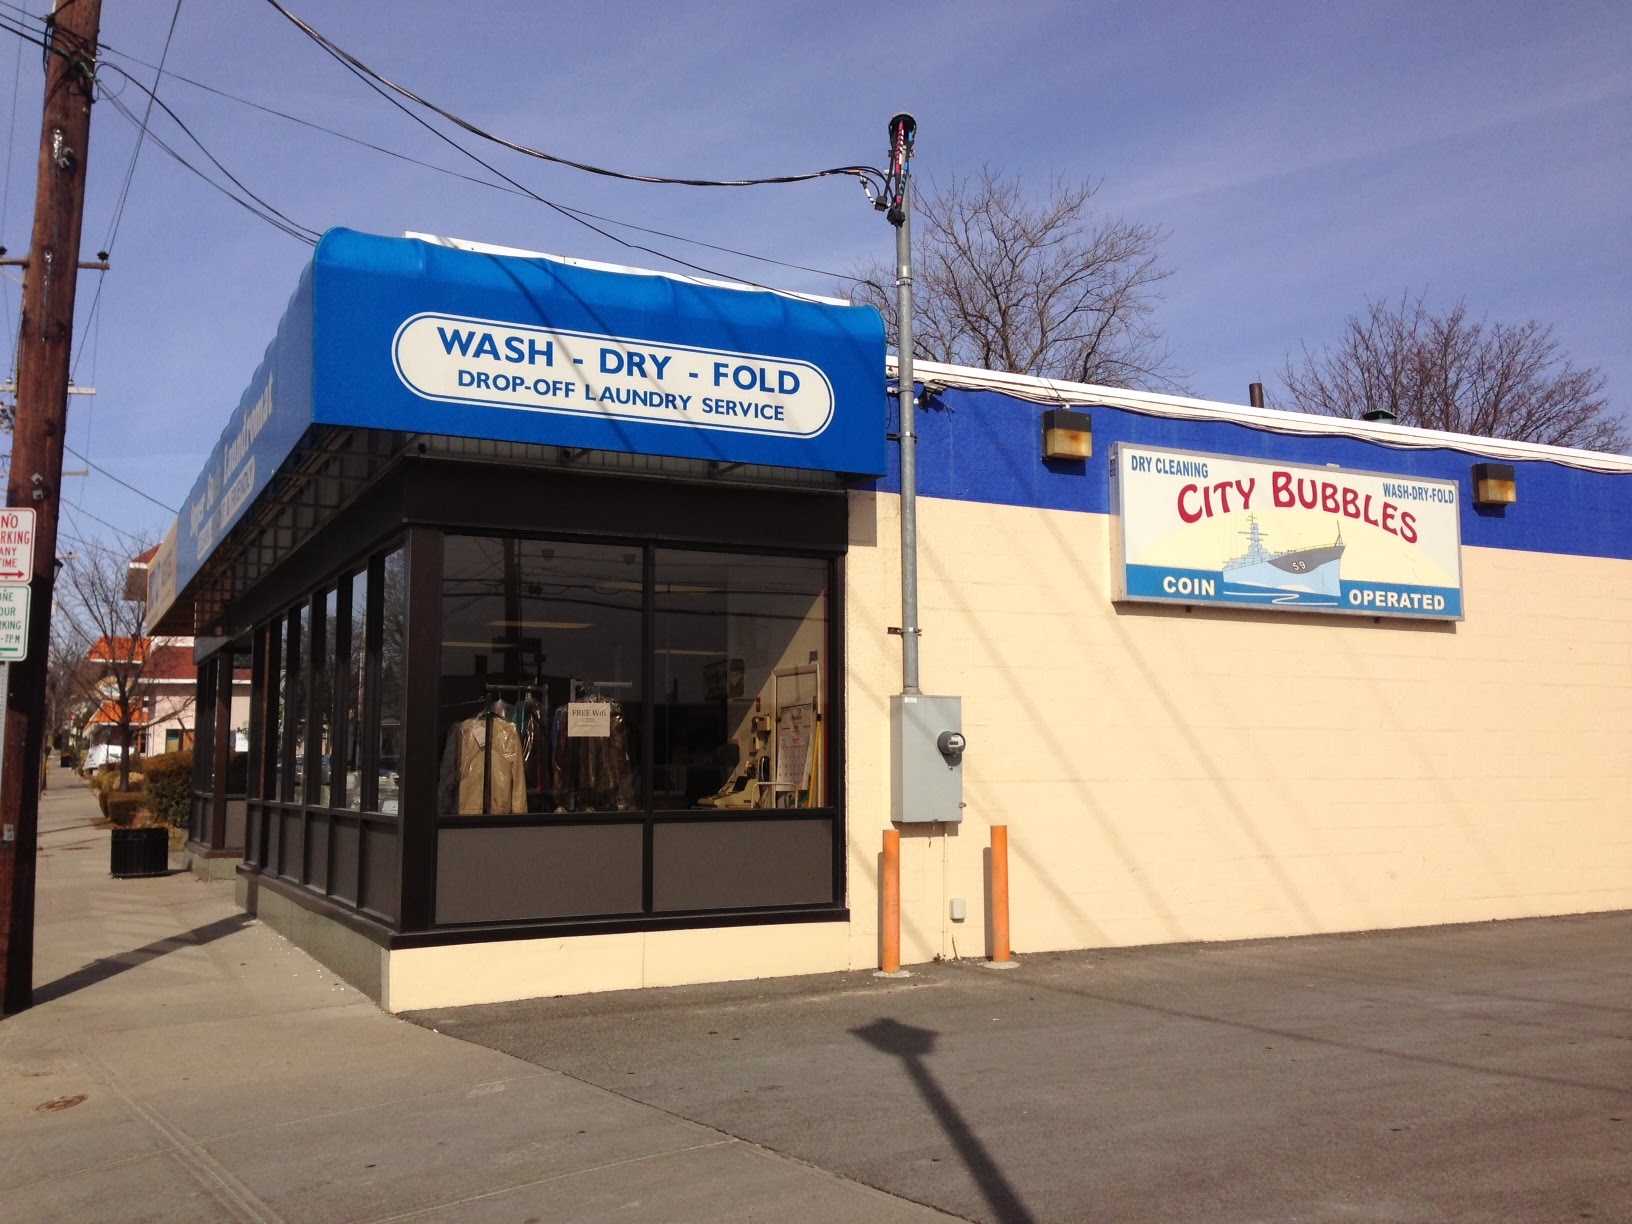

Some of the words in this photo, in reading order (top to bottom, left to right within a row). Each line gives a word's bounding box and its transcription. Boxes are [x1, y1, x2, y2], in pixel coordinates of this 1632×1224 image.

[437, 327, 554, 367] WASH
[600, 348, 672, 380] DRY
[713, 362, 800, 394] FOLD
[457, 370, 576, 398] DROP-OFF
[584, 383, 692, 412] LAUNDRY
[702, 397, 785, 421] SERVICE
[1131, 455, 1152, 472] DRY
[1155, 458, 1209, 478] CLEANING
[1383, 482, 1454, 504] WASH-DRY-FOLD
[1177, 477, 1255, 523] CITY
[1272, 471, 1418, 544] BUBBLES
[1, 515, 18, 528] NO
[1292, 560, 1306, 571] 59
[1163, 576, 1215, 596] COIN
[1349, 588, 1445, 611] OPERATED
[0, 620, 21, 630] KING
[572, 709, 591, 717] FREE
